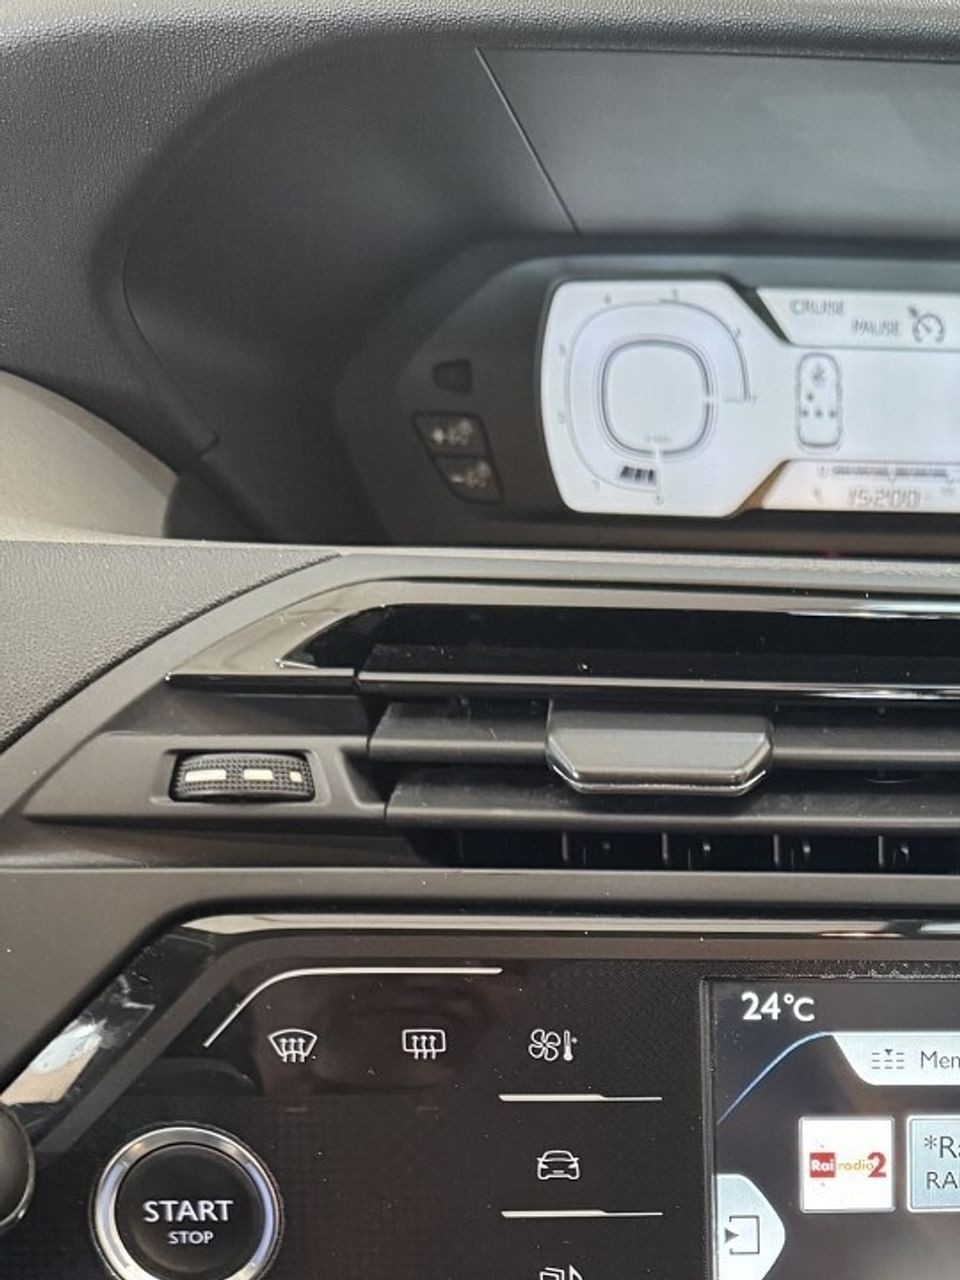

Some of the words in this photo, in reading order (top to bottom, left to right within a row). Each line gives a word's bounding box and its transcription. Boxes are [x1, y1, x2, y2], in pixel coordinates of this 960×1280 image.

[741, 991, 815, 1021] 24°C
[811, 1159, 834, 1171] Rai
[142, 1199, 234, 1223] START
[168, 1229, 214, 1246] STOP
